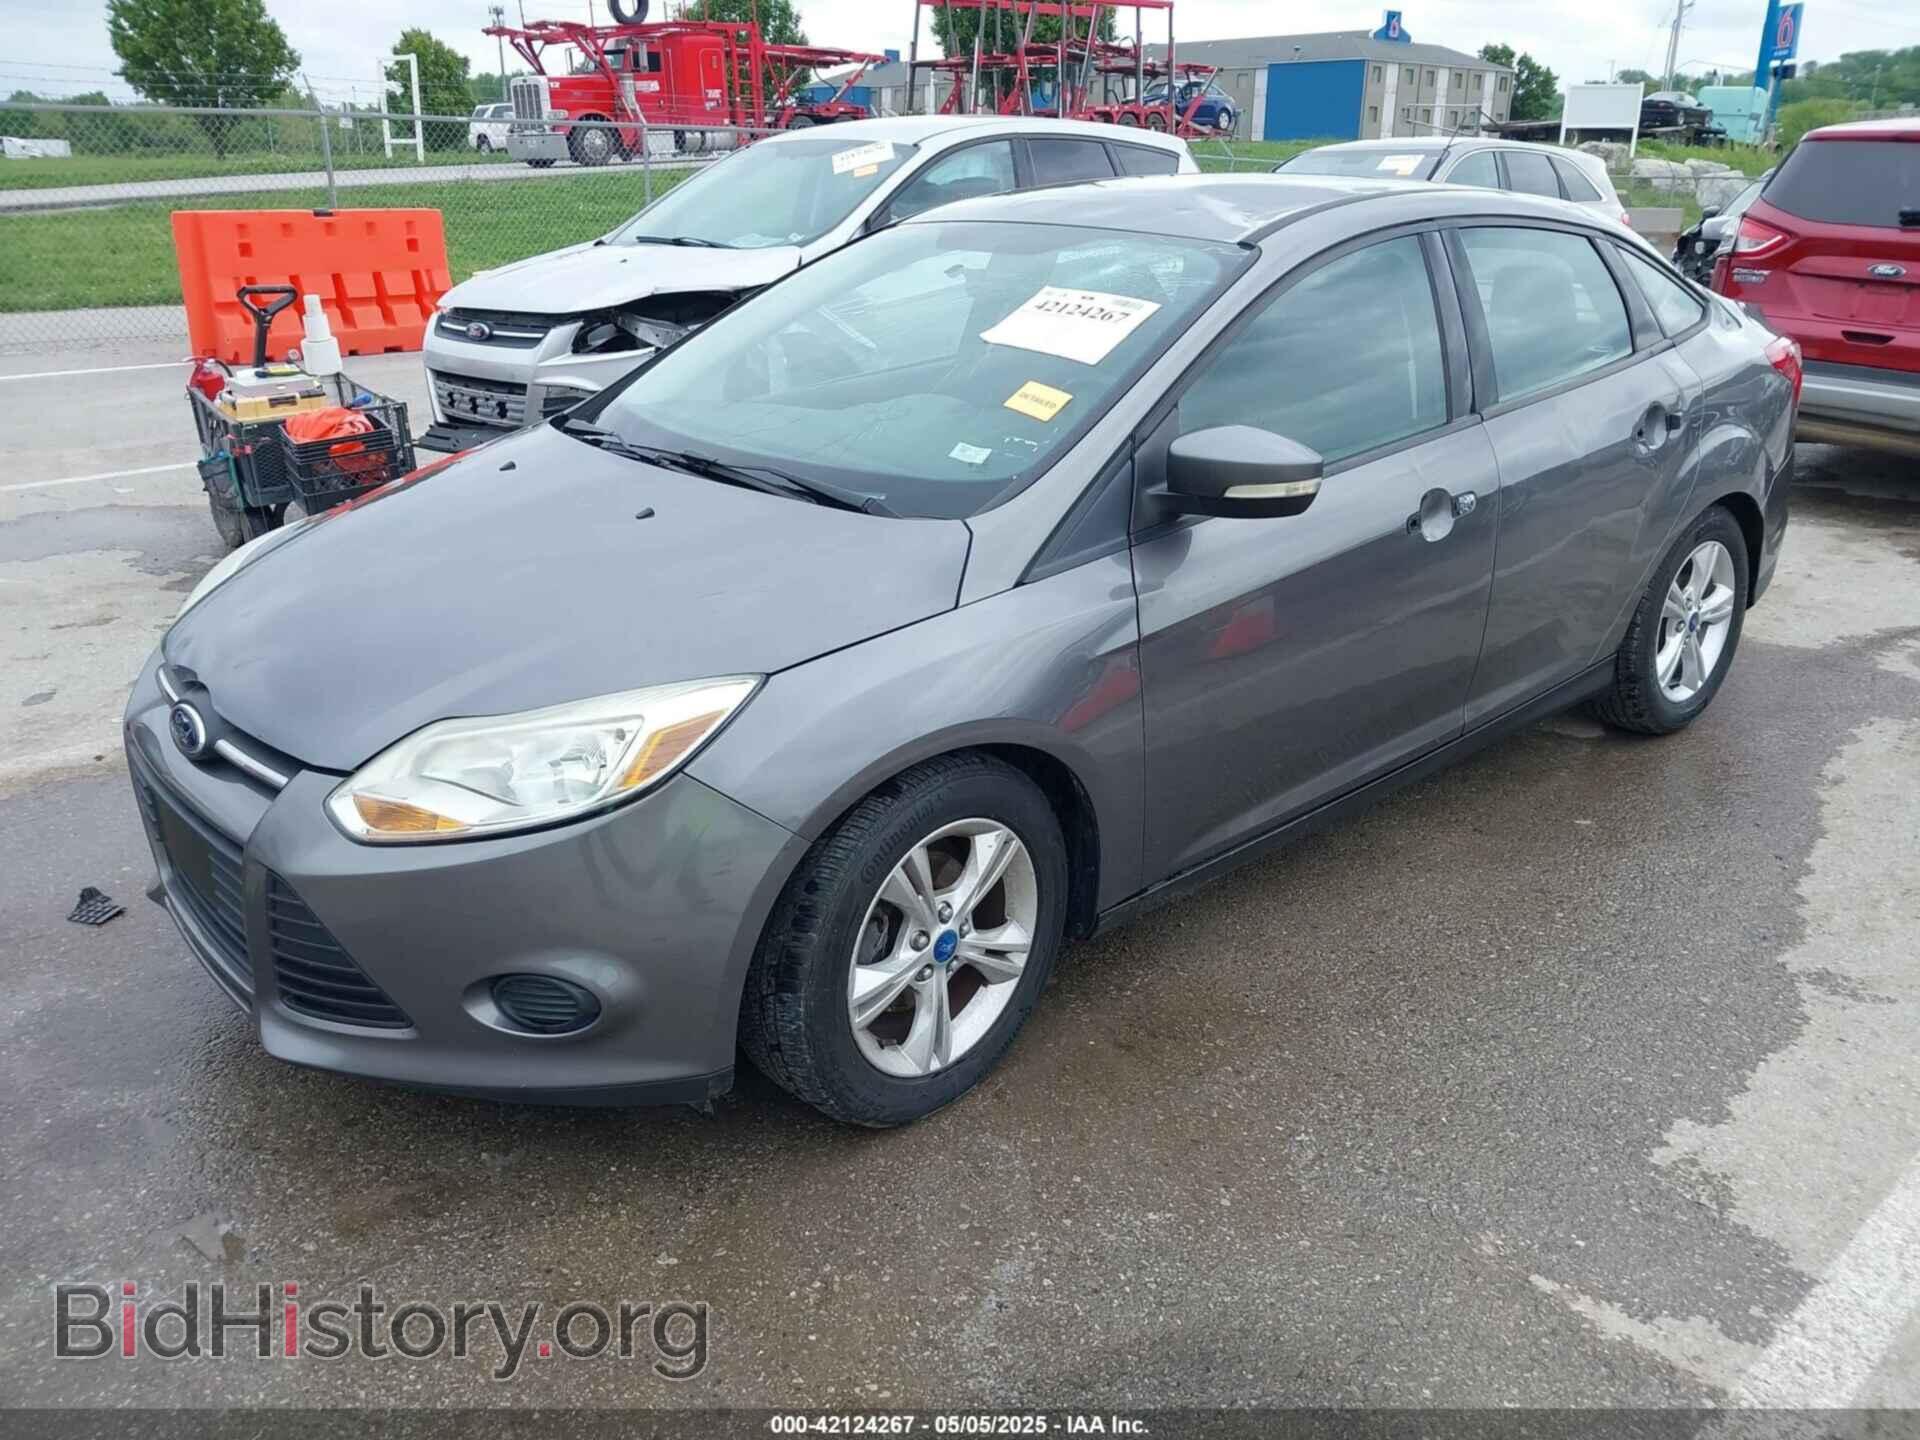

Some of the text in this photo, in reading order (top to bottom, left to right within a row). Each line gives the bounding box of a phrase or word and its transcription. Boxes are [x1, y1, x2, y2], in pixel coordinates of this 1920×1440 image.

[1388, 15, 1399, 39] 6
[1777, 5, 1794, 48] 6
[1034, 300, 1131, 323] 42124267
